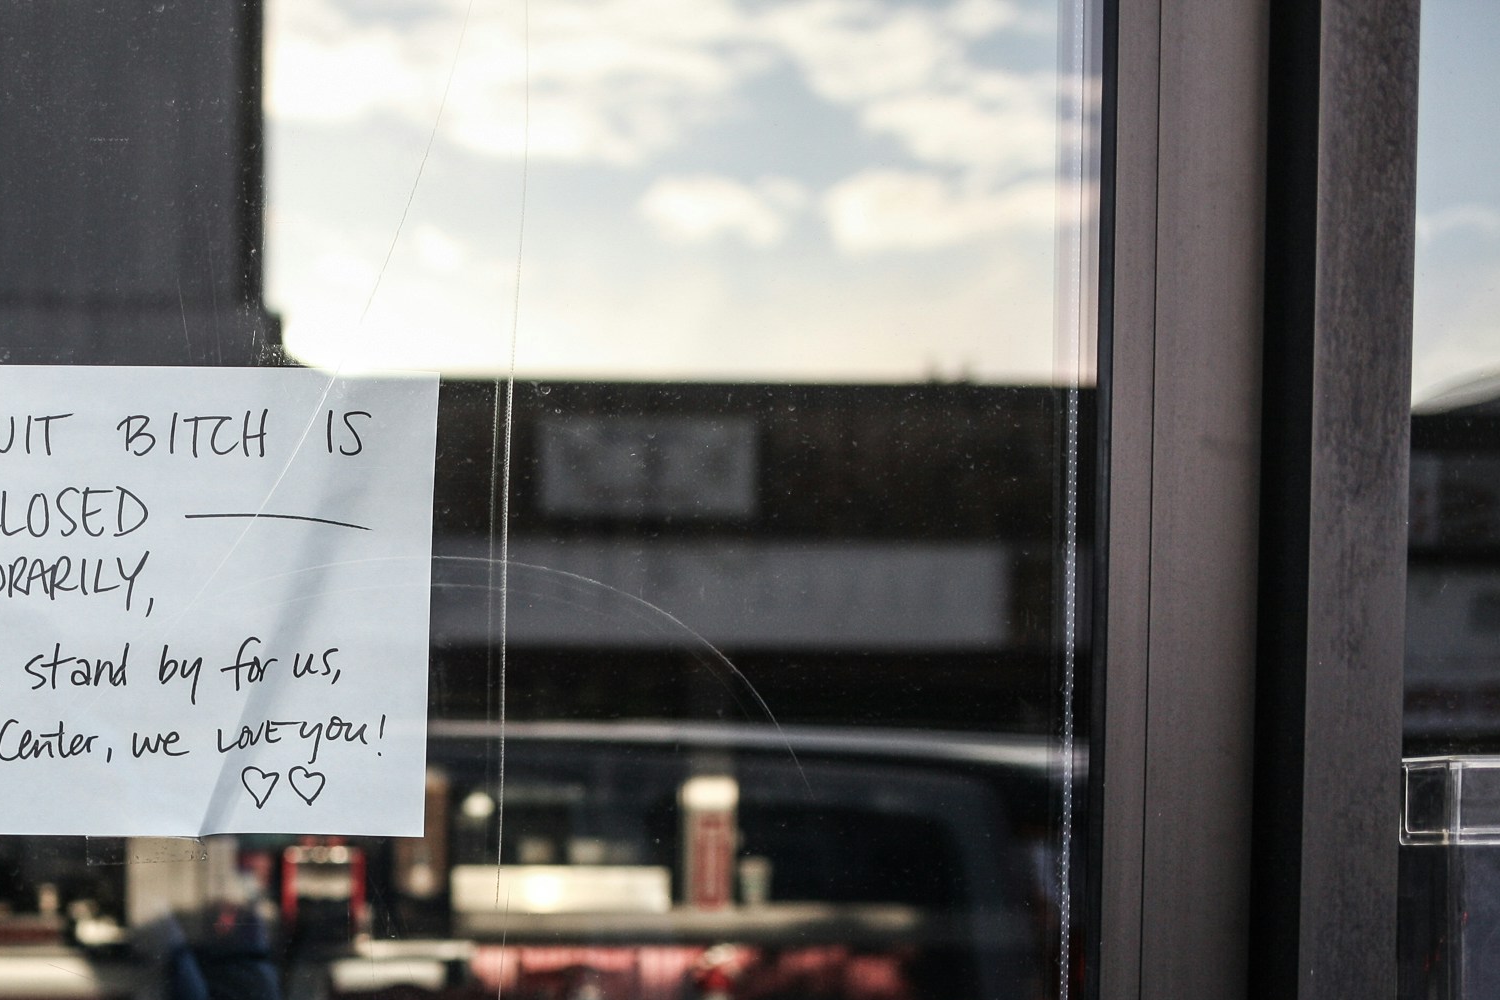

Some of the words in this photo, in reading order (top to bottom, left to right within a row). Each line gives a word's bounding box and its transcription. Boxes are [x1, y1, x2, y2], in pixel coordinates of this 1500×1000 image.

[117, 408, 269, 459] BITCH
[326, 409, 373, 457] IS
[23, 642, 129, 692] stand
[158, 639, 204, 705] by
[219, 636, 278, 692] for
[292, 645, 342, 684] us,
[131, 730, 191, 757] we
[299, 713, 387, 764] you!
